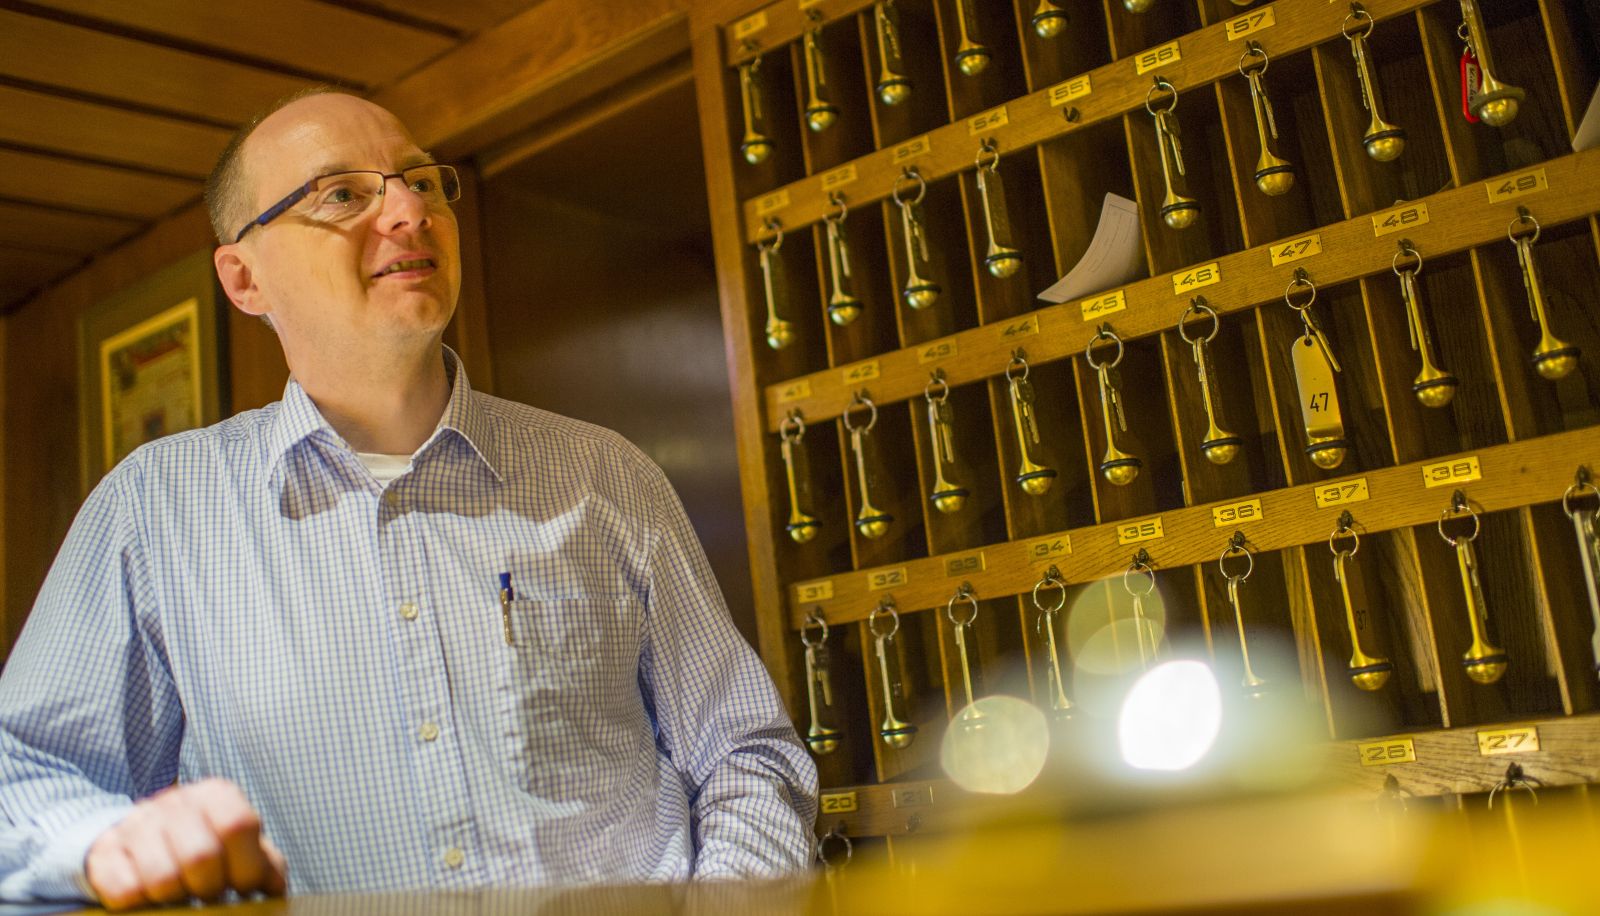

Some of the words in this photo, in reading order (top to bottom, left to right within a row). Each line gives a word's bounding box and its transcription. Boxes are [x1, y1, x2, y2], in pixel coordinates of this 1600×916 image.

[1234, 12, 1266, 33] 57
[1142, 47, 1173, 67] 56
[1054, 81, 1084, 99] 55
[974, 113, 1001, 130] 54
[897, 141, 923, 158] 53
[826, 169, 850, 185] 52
[1497, 177, 1536, 194] 49
[1382, 209, 1417, 227] 48
[1279, 240, 1312, 259] 47
[1181, 269, 1211, 287] 46
[1091, 296, 1117, 312] 45
[1004, 321, 1030, 336] 44
[925, 344, 949, 358] 43
[850, 365, 873, 378] 42
[1310, 393, 1329, 412] 47
[1432, 463, 1471, 481] 38
[1324, 484, 1359, 502] 37
[1220, 504, 1254, 521] 36
[1124, 524, 1155, 539] 35
[1035, 541, 1064, 556] 34
[949, 556, 977, 571] 33
[875, 571, 899, 585] 32
[805, 585, 825, 599] 31
[1488, 733, 1528, 748] 27
[1367, 745, 1406, 760] 26
[826, 797, 851, 810] 20
